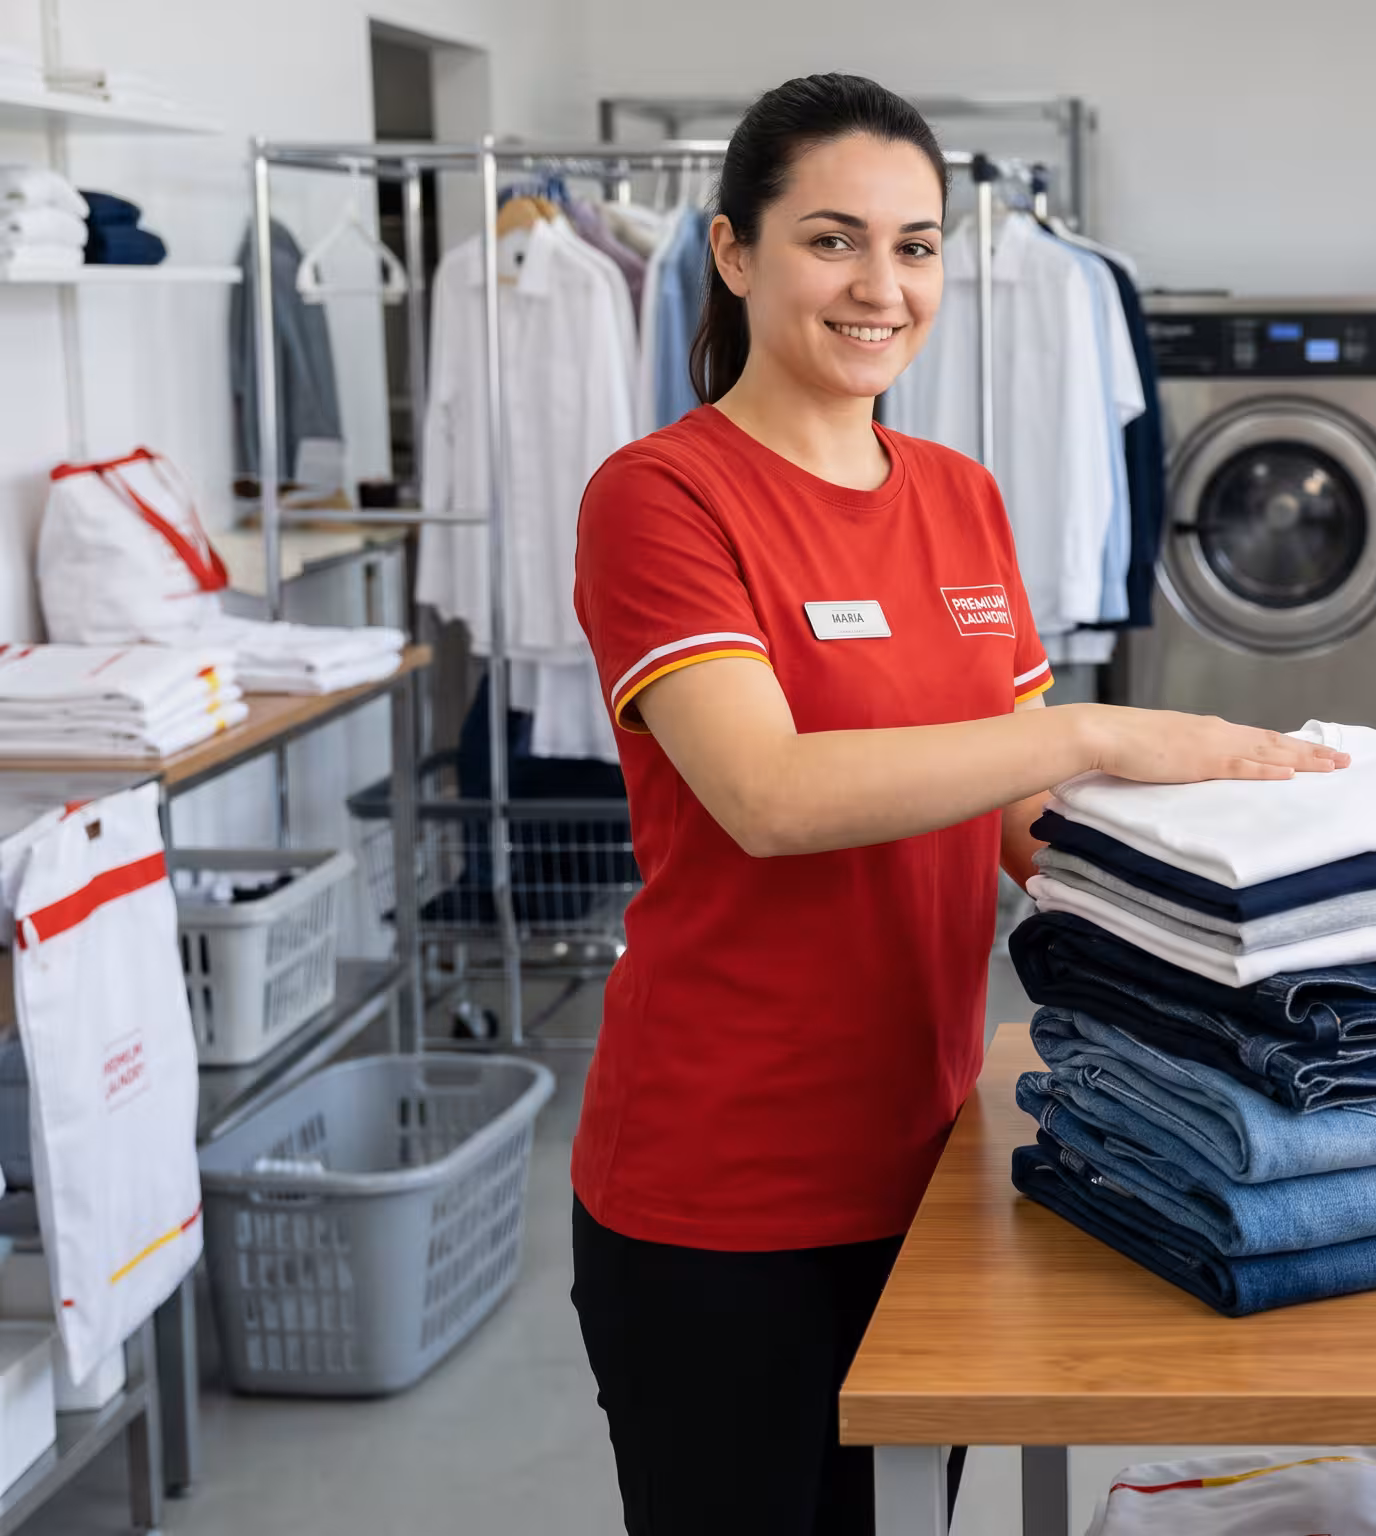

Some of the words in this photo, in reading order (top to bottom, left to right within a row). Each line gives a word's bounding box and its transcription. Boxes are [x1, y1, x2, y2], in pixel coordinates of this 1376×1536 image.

[952, 595, 1006, 610] PREMIUM
[831, 613, 865, 623] MARIA
[958, 611, 1009, 624] LAUNDRY
